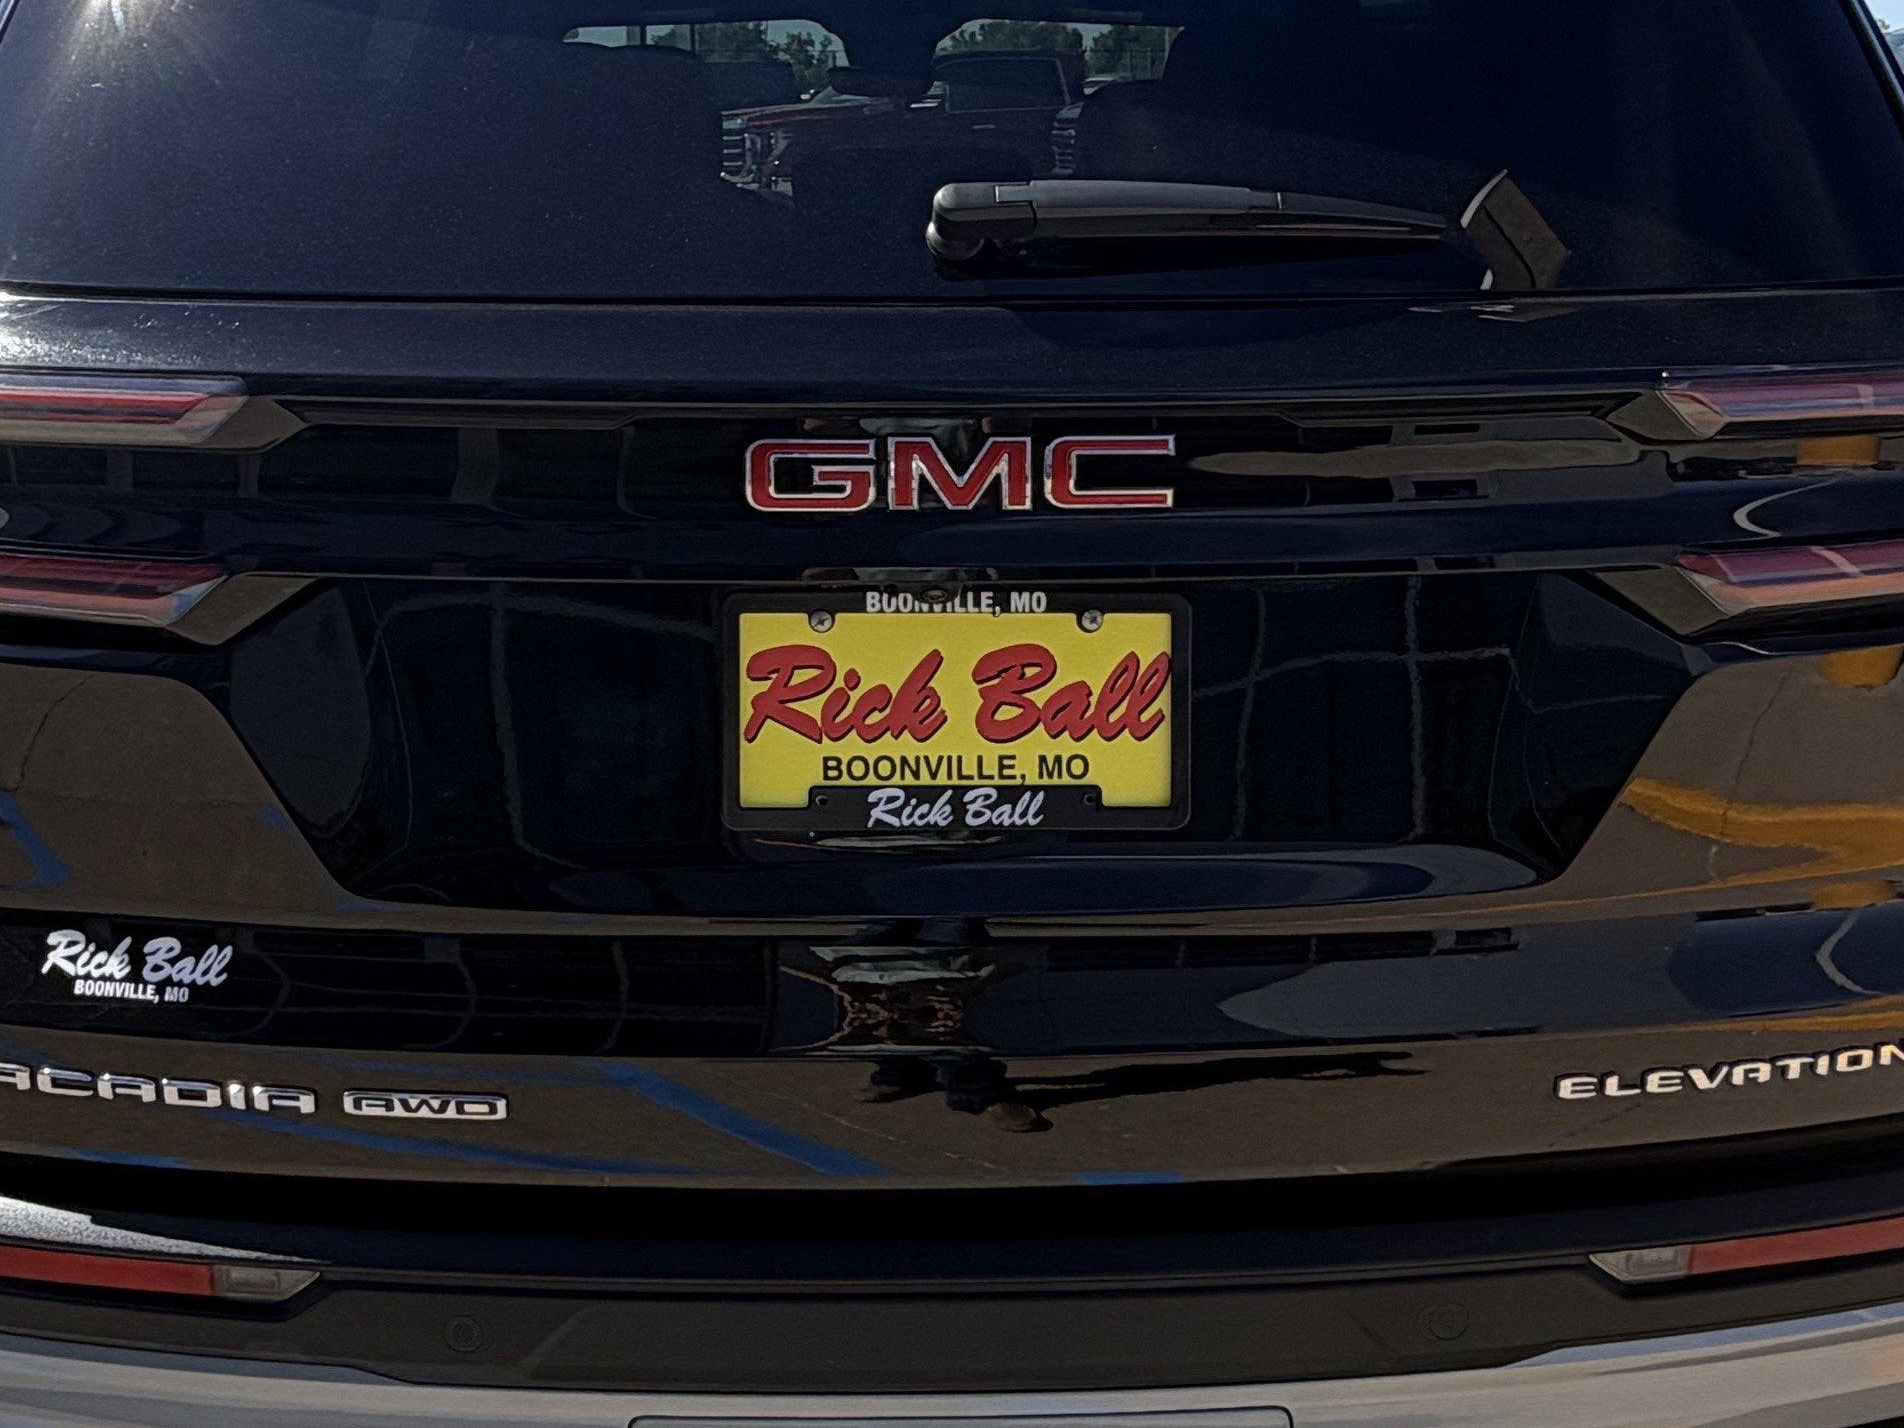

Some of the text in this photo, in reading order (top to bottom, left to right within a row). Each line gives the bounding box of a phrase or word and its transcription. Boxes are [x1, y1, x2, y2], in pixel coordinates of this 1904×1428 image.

[745, 434, 1176, 512] GMC
[1010, 591, 1047, 613] MO
[743, 643, 1173, 744] Rick Ball
[822, 754, 1090, 784] BOONVILLE, MO
[867, 787, 1045, 828] Rick Ball
[41, 929, 233, 986] Rick Ball
[73, 979, 190, 1003] BOONVILLE, MO
[346, 1091, 505, 1119] AWD
